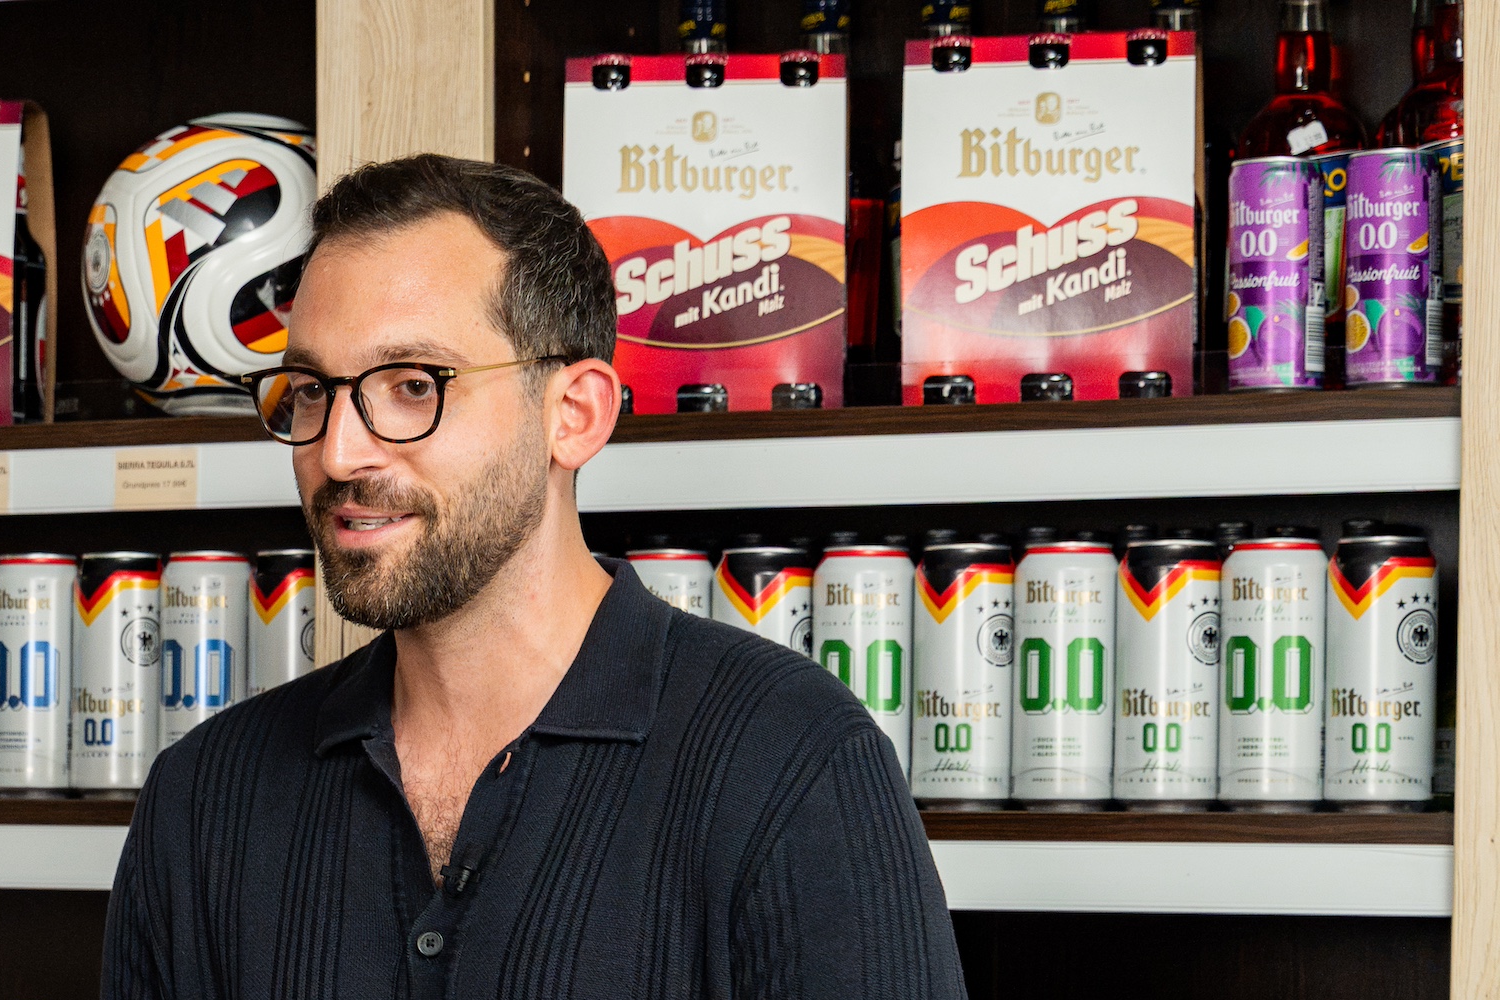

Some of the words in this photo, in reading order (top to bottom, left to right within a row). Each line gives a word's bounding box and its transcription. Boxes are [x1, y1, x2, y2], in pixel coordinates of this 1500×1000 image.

[956, 126, 1140, 183] Bitburger
[617, 143, 793, 201] Bitburger
[954, 198, 1139, 304] Schuss
[1240, 228, 1279, 258] 0.0
[1359, 221, 1400, 251] 0.0
[615, 215, 791, 316] Schuss
[1017, 293, 1043, 316] mit
[1045, 247, 1127, 306] Kandi
[674, 306, 700, 329] mit
[702, 262, 780, 319] Kandi
[758, 294, 785, 317] Malz
[1104, 280, 1132, 303] Malz
[1020, 637, 1105, 712] 0.0
[1226, 635, 1312, 711] 0.0
[917, 690, 1001, 722] Bitburger
[1121, 688, 1210, 722] Bitburger
[1331, 687, 1420, 721] Bitburger
[84, 718, 115, 746] 0.0
[935, 723, 972, 752] 0.0
